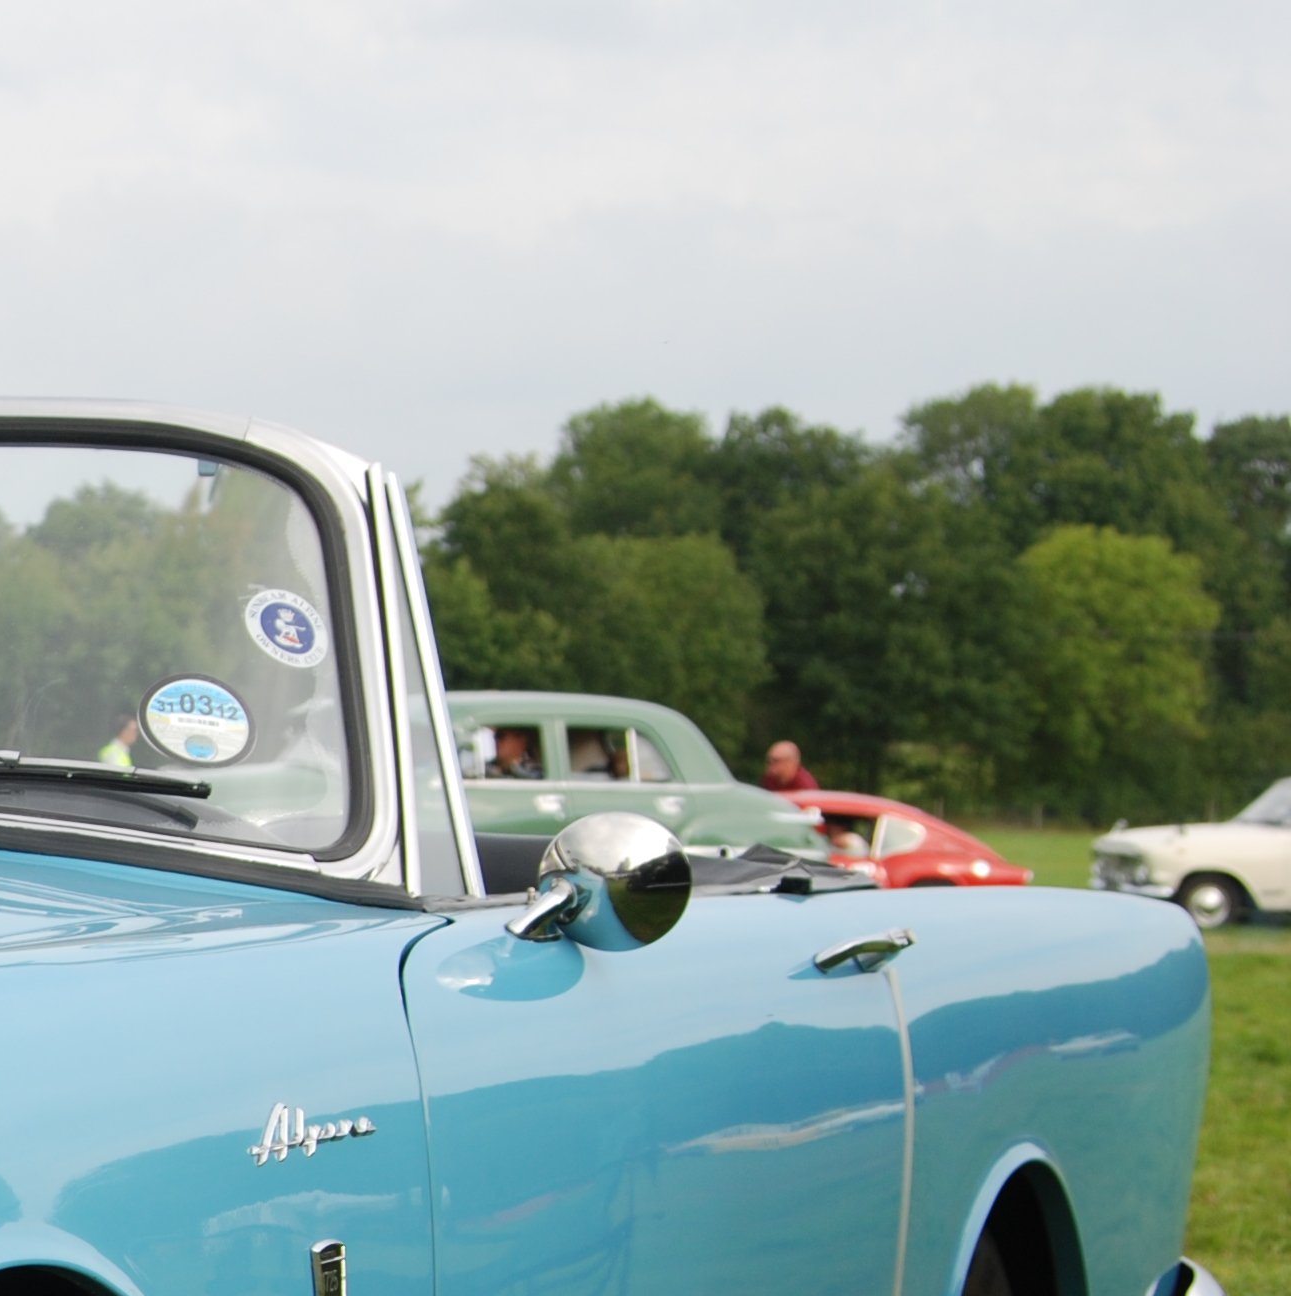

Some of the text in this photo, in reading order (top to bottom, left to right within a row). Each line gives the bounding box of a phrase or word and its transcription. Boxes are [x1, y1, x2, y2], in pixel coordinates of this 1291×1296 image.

[157, 693, 239, 721] 31 03 12
